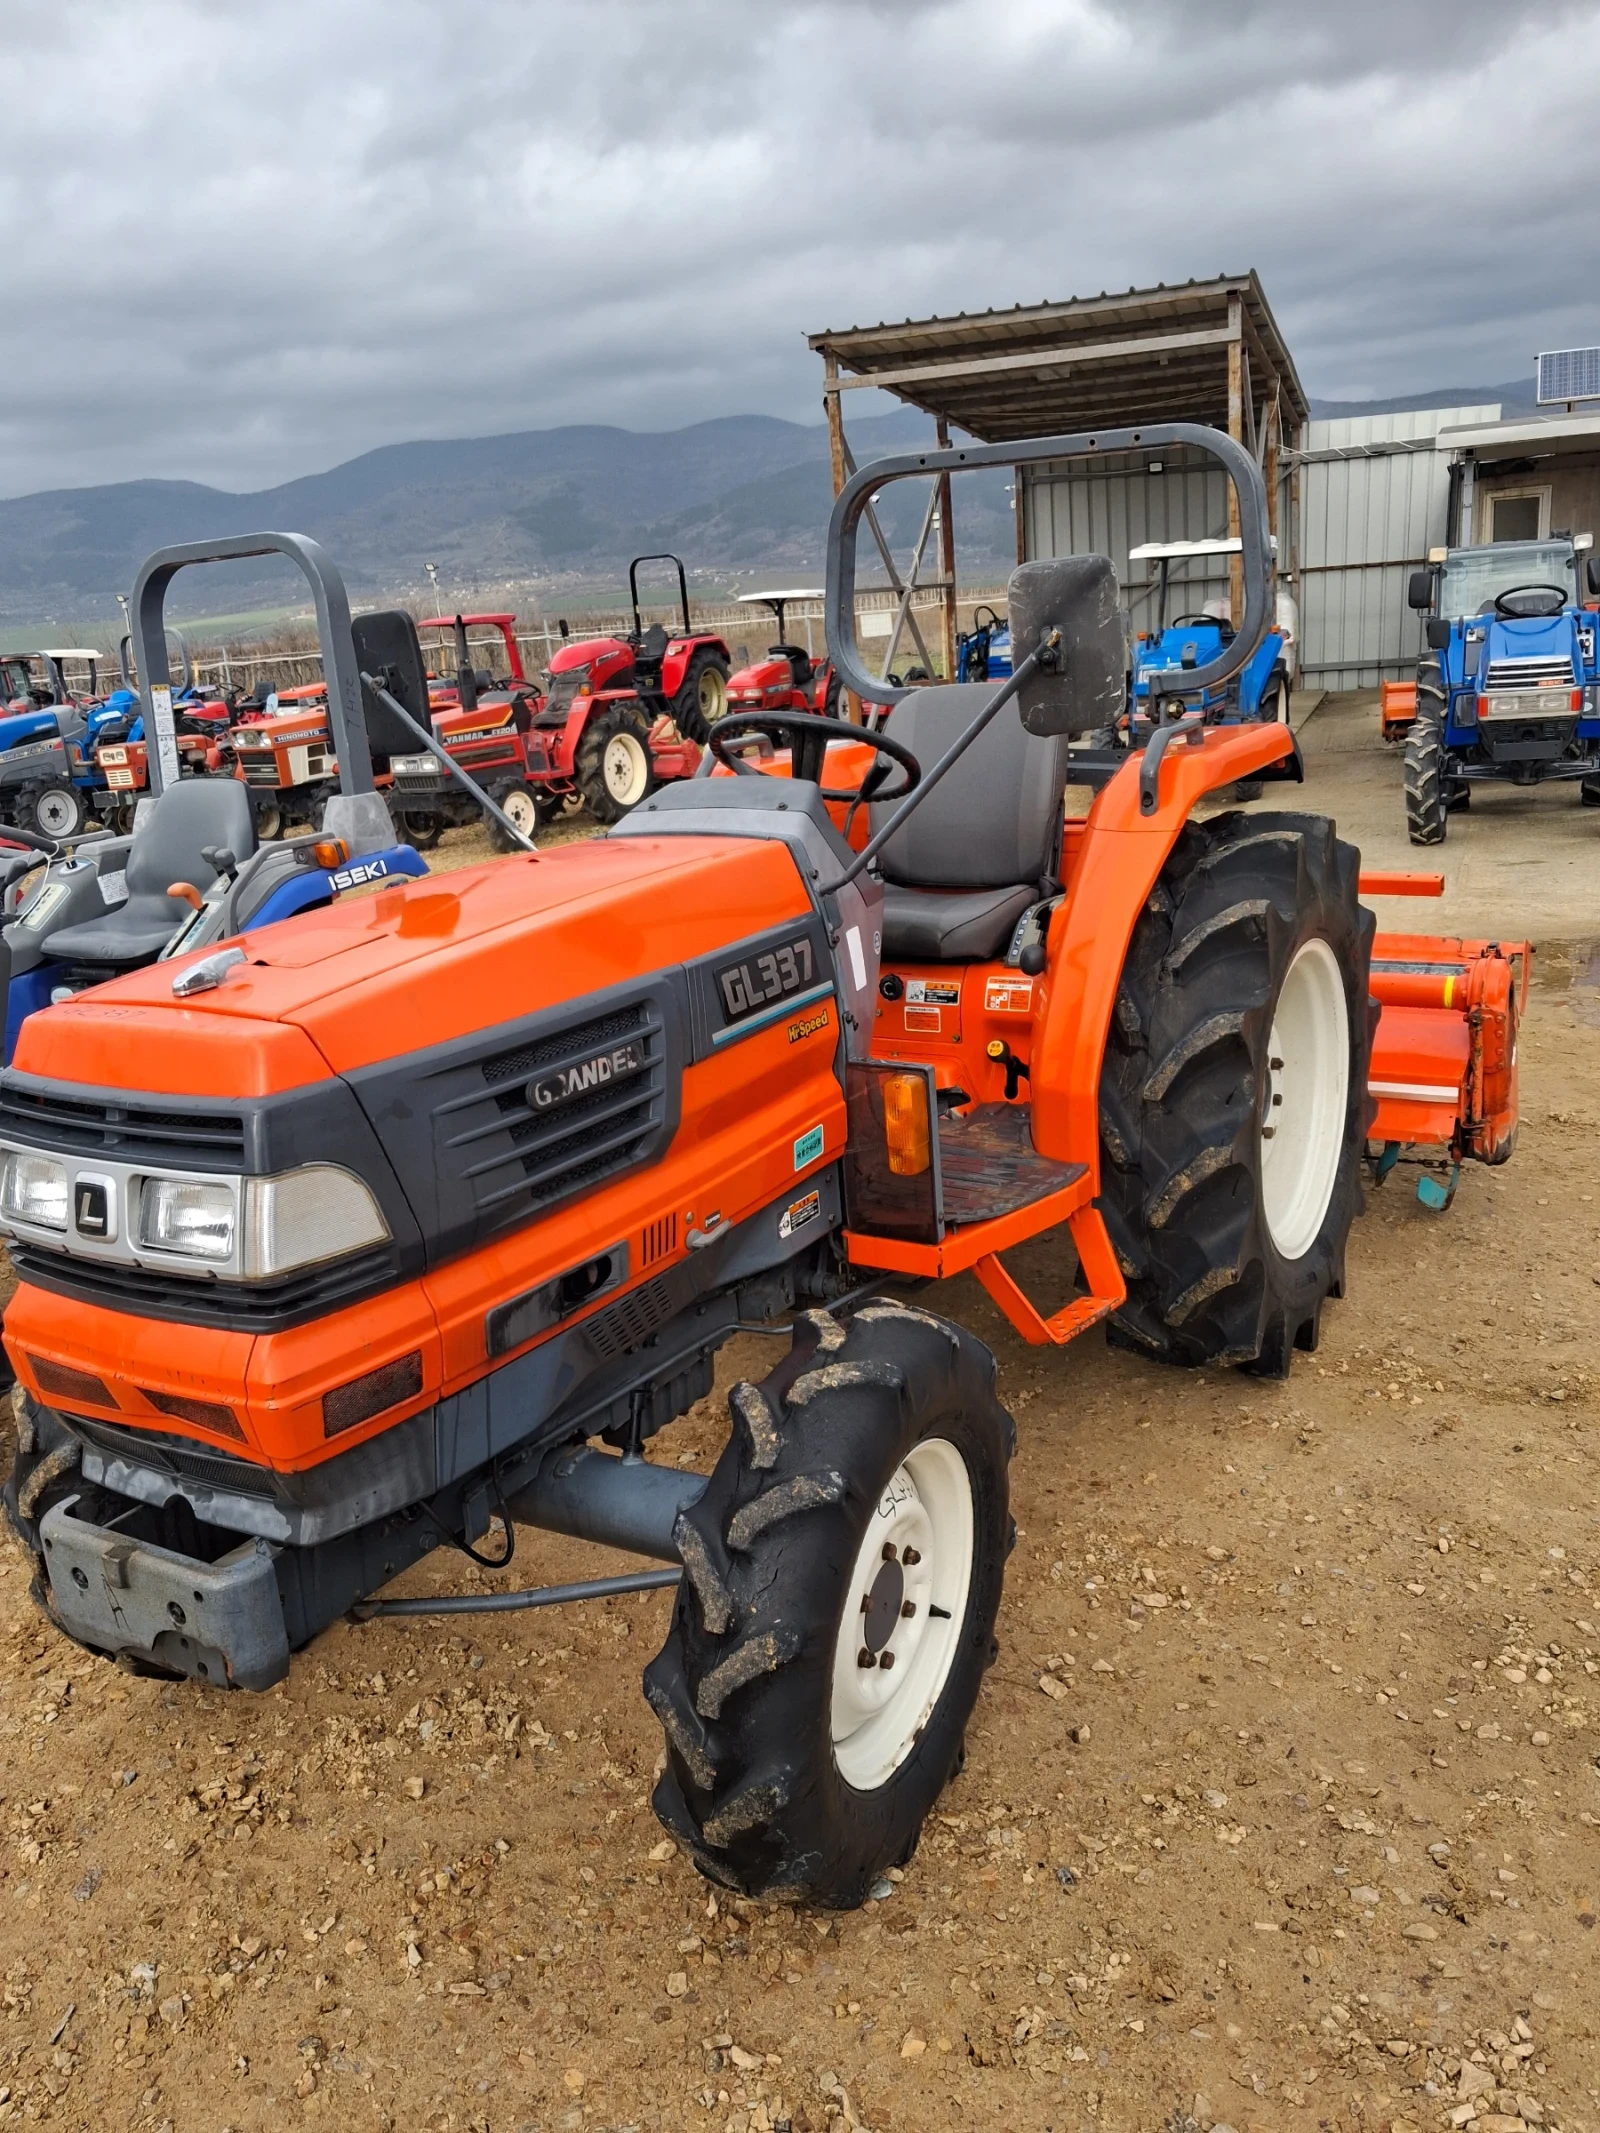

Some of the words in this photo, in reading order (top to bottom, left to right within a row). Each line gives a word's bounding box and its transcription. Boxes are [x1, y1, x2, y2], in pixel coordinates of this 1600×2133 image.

[278, 729, 320, 742] HINOMOTO
[446, 731, 484, 745] YANMAR
[328, 860, 388, 891] ISEKI
[721, 939, 812, 1015] GL337
[79, 1192, 104, 1228] L
